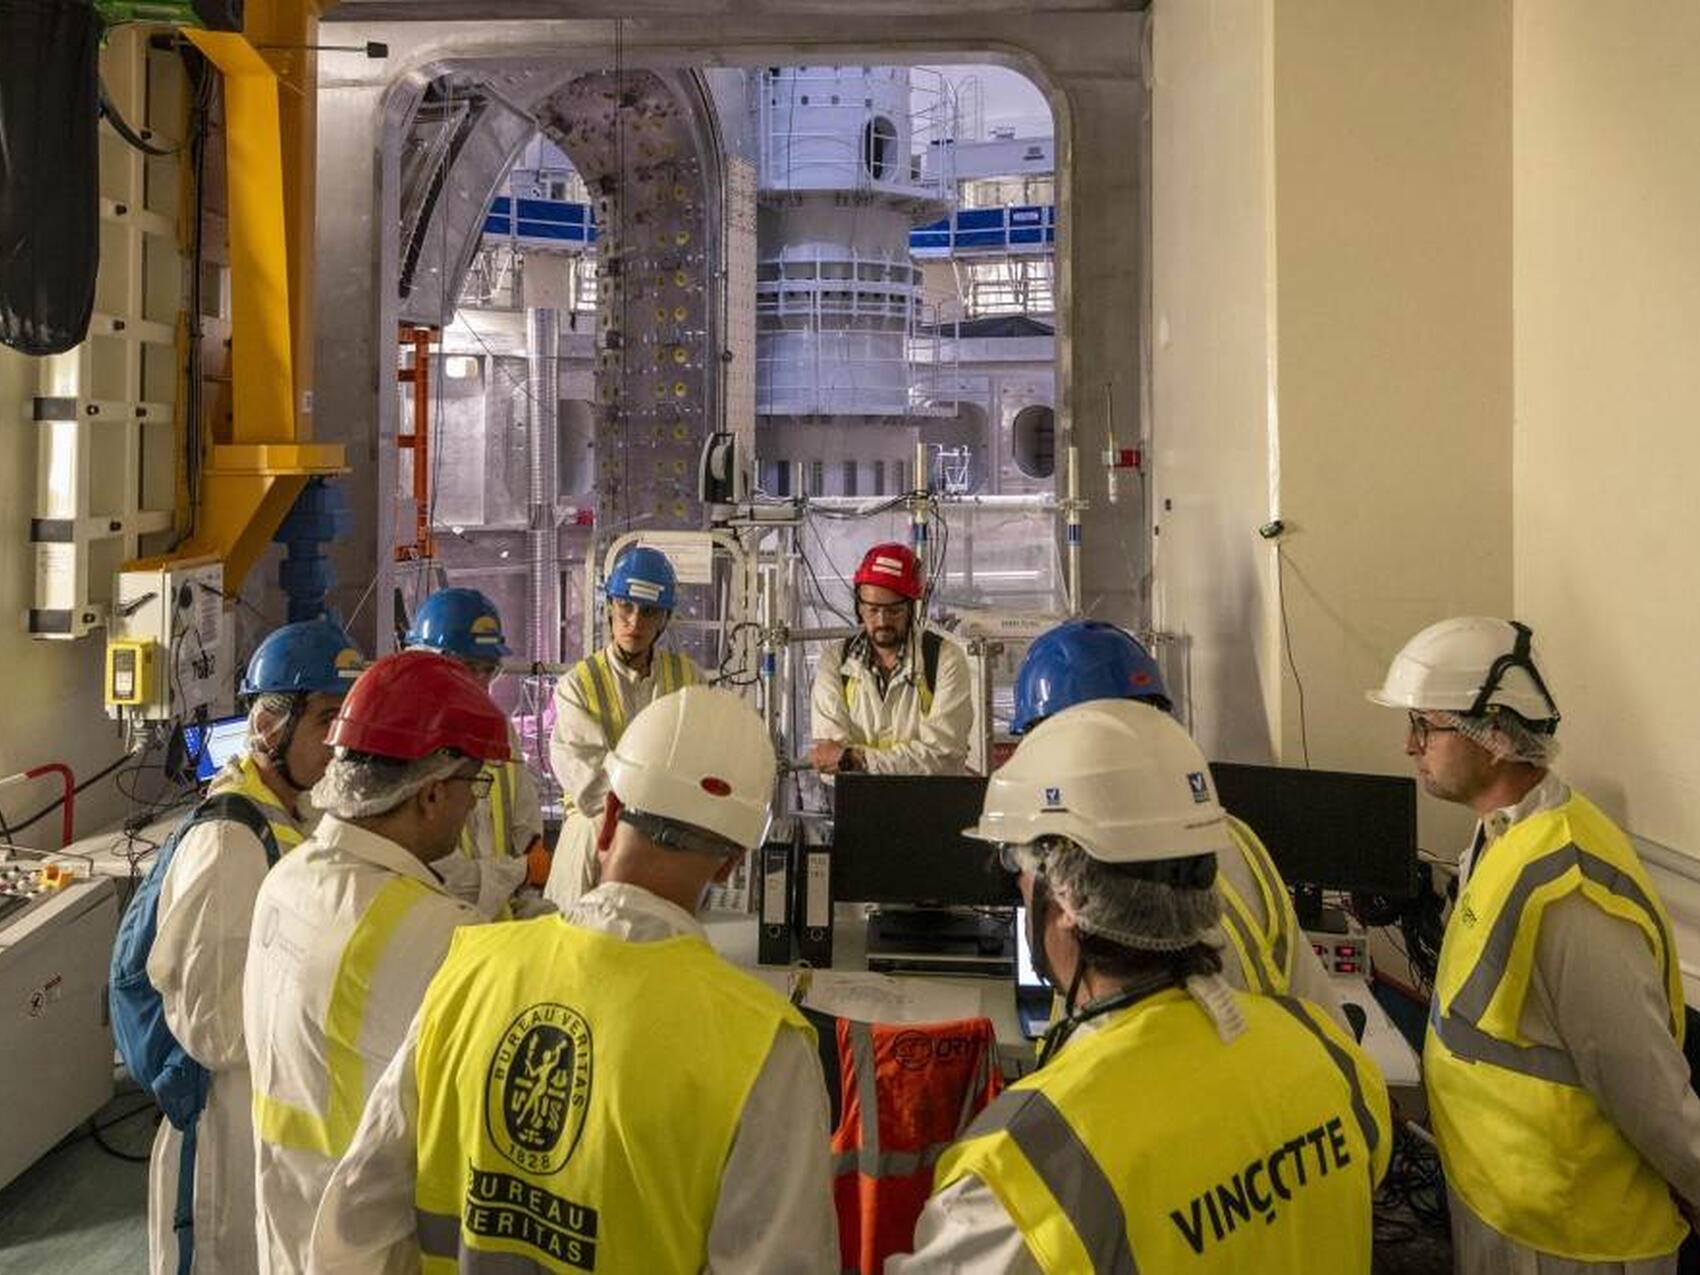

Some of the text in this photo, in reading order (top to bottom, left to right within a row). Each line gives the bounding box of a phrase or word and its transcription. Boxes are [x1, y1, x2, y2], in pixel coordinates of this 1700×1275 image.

[494, 1008, 590, 1107] BUREAU VERITAS
[508, 1143, 551, 1169] 1828
